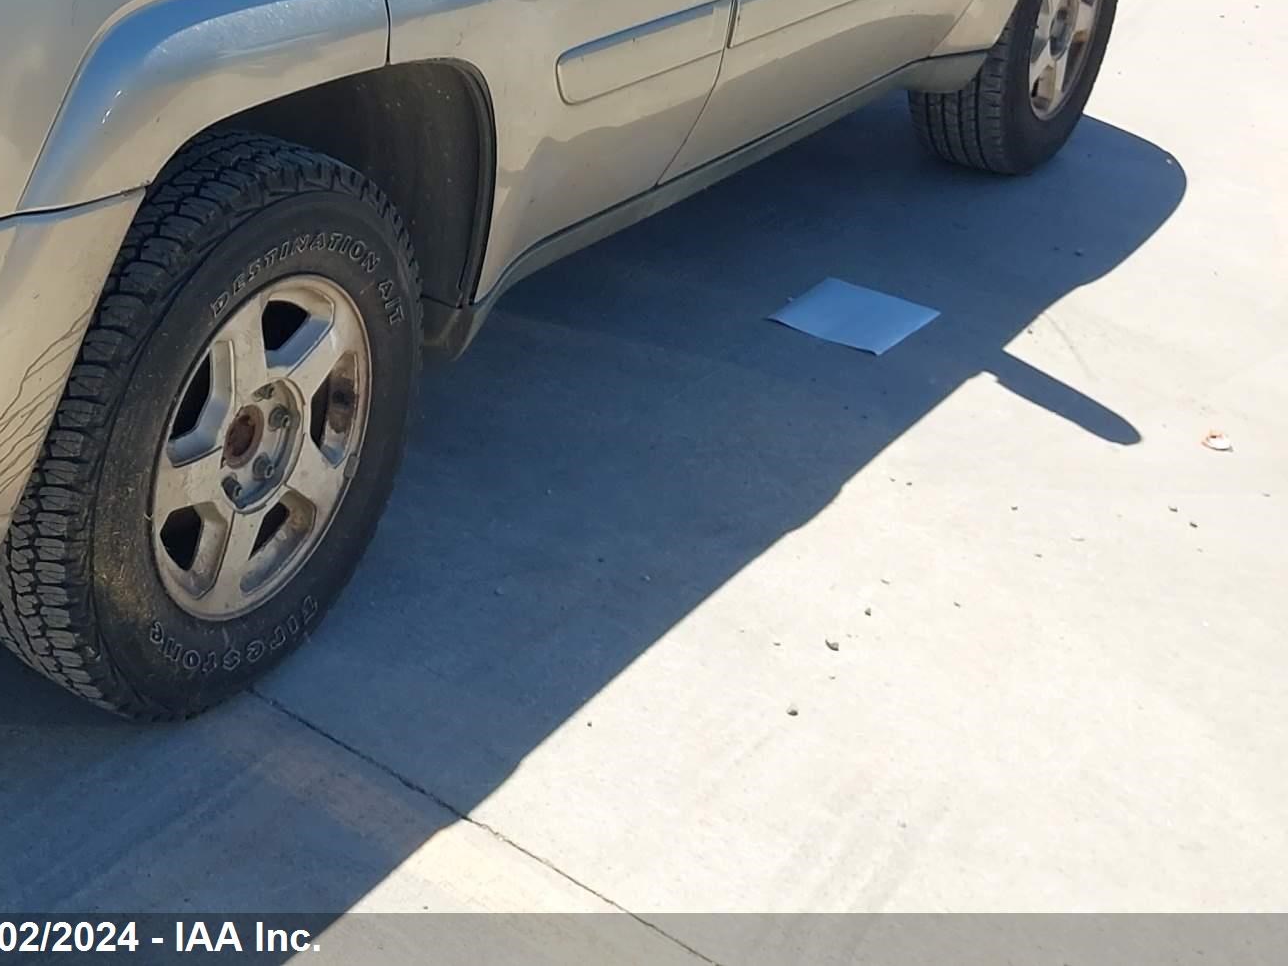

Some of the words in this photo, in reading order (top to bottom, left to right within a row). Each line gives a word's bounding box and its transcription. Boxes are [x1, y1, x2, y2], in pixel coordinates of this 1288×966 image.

[210, 233, 381, 318] DESTINATION
[378, 279, 405, 325] A/T
[149, 595, 318, 674] Firestone
